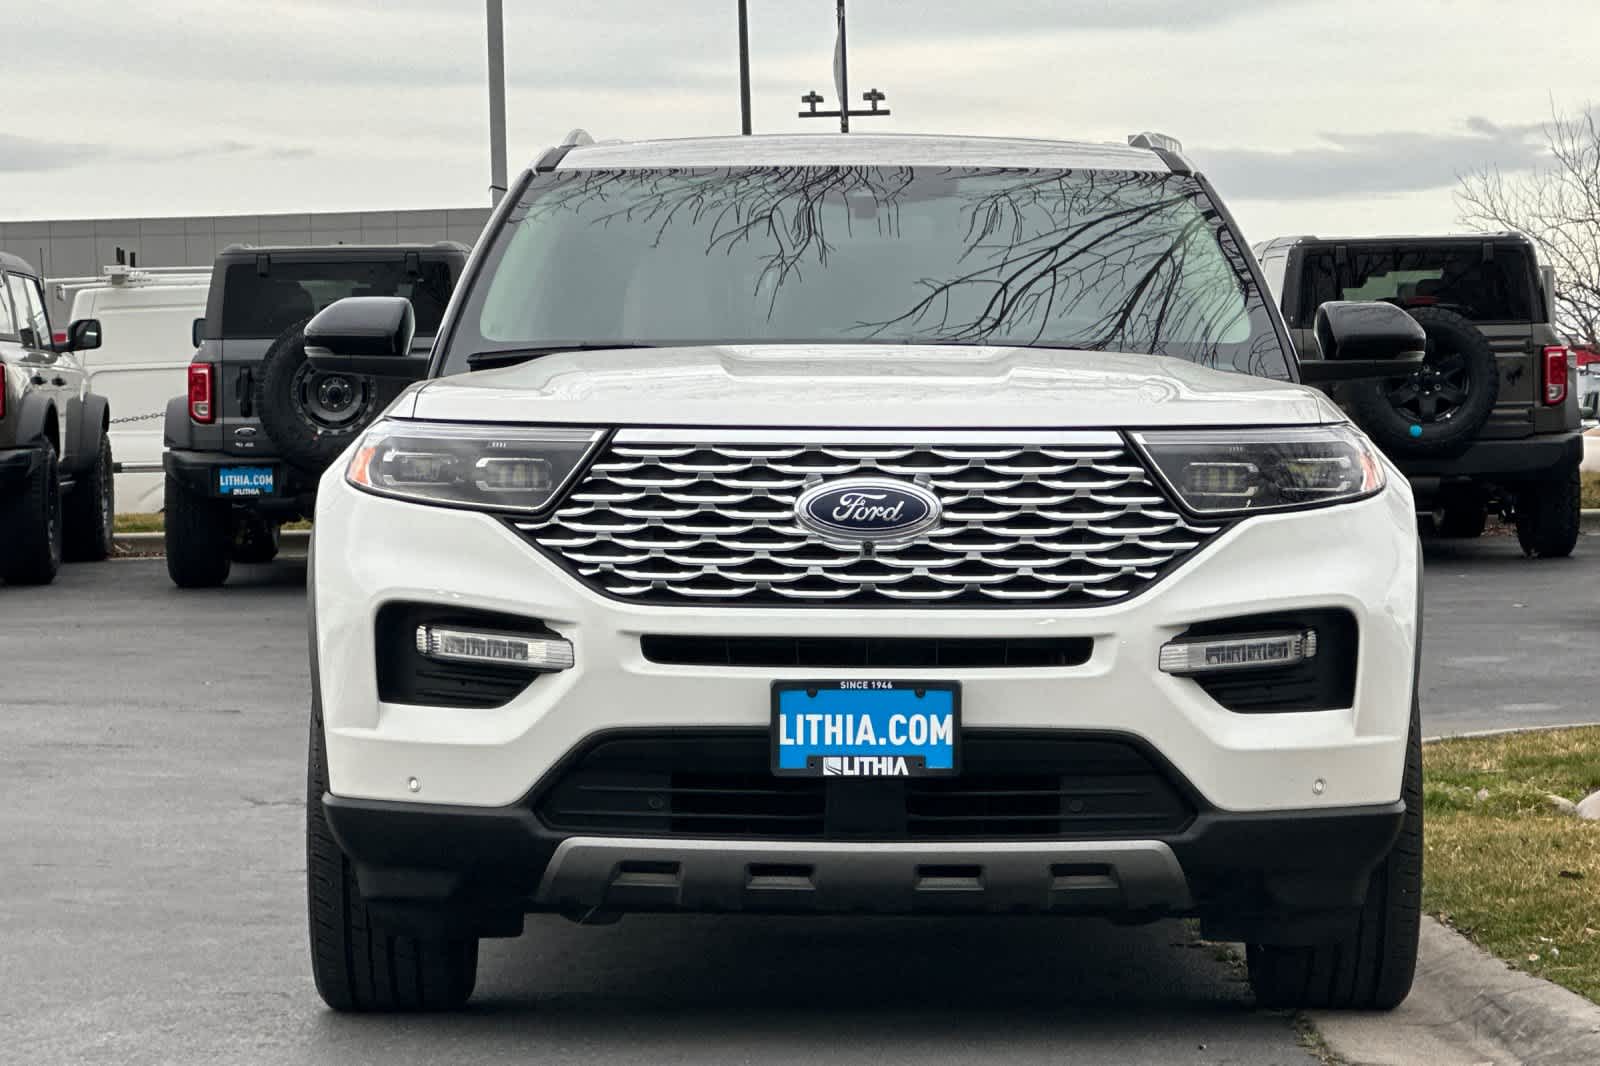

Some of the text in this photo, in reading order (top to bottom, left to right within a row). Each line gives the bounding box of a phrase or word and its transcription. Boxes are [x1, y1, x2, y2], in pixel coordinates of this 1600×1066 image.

[220, 474, 273, 486] LITHIA.COM
[832, 492, 905, 522] Ford
[840, 681, 893, 689] SINCE 1946
[779, 714, 953, 746] LITHIA.COM
[843, 756, 909, 776] LITHIA
